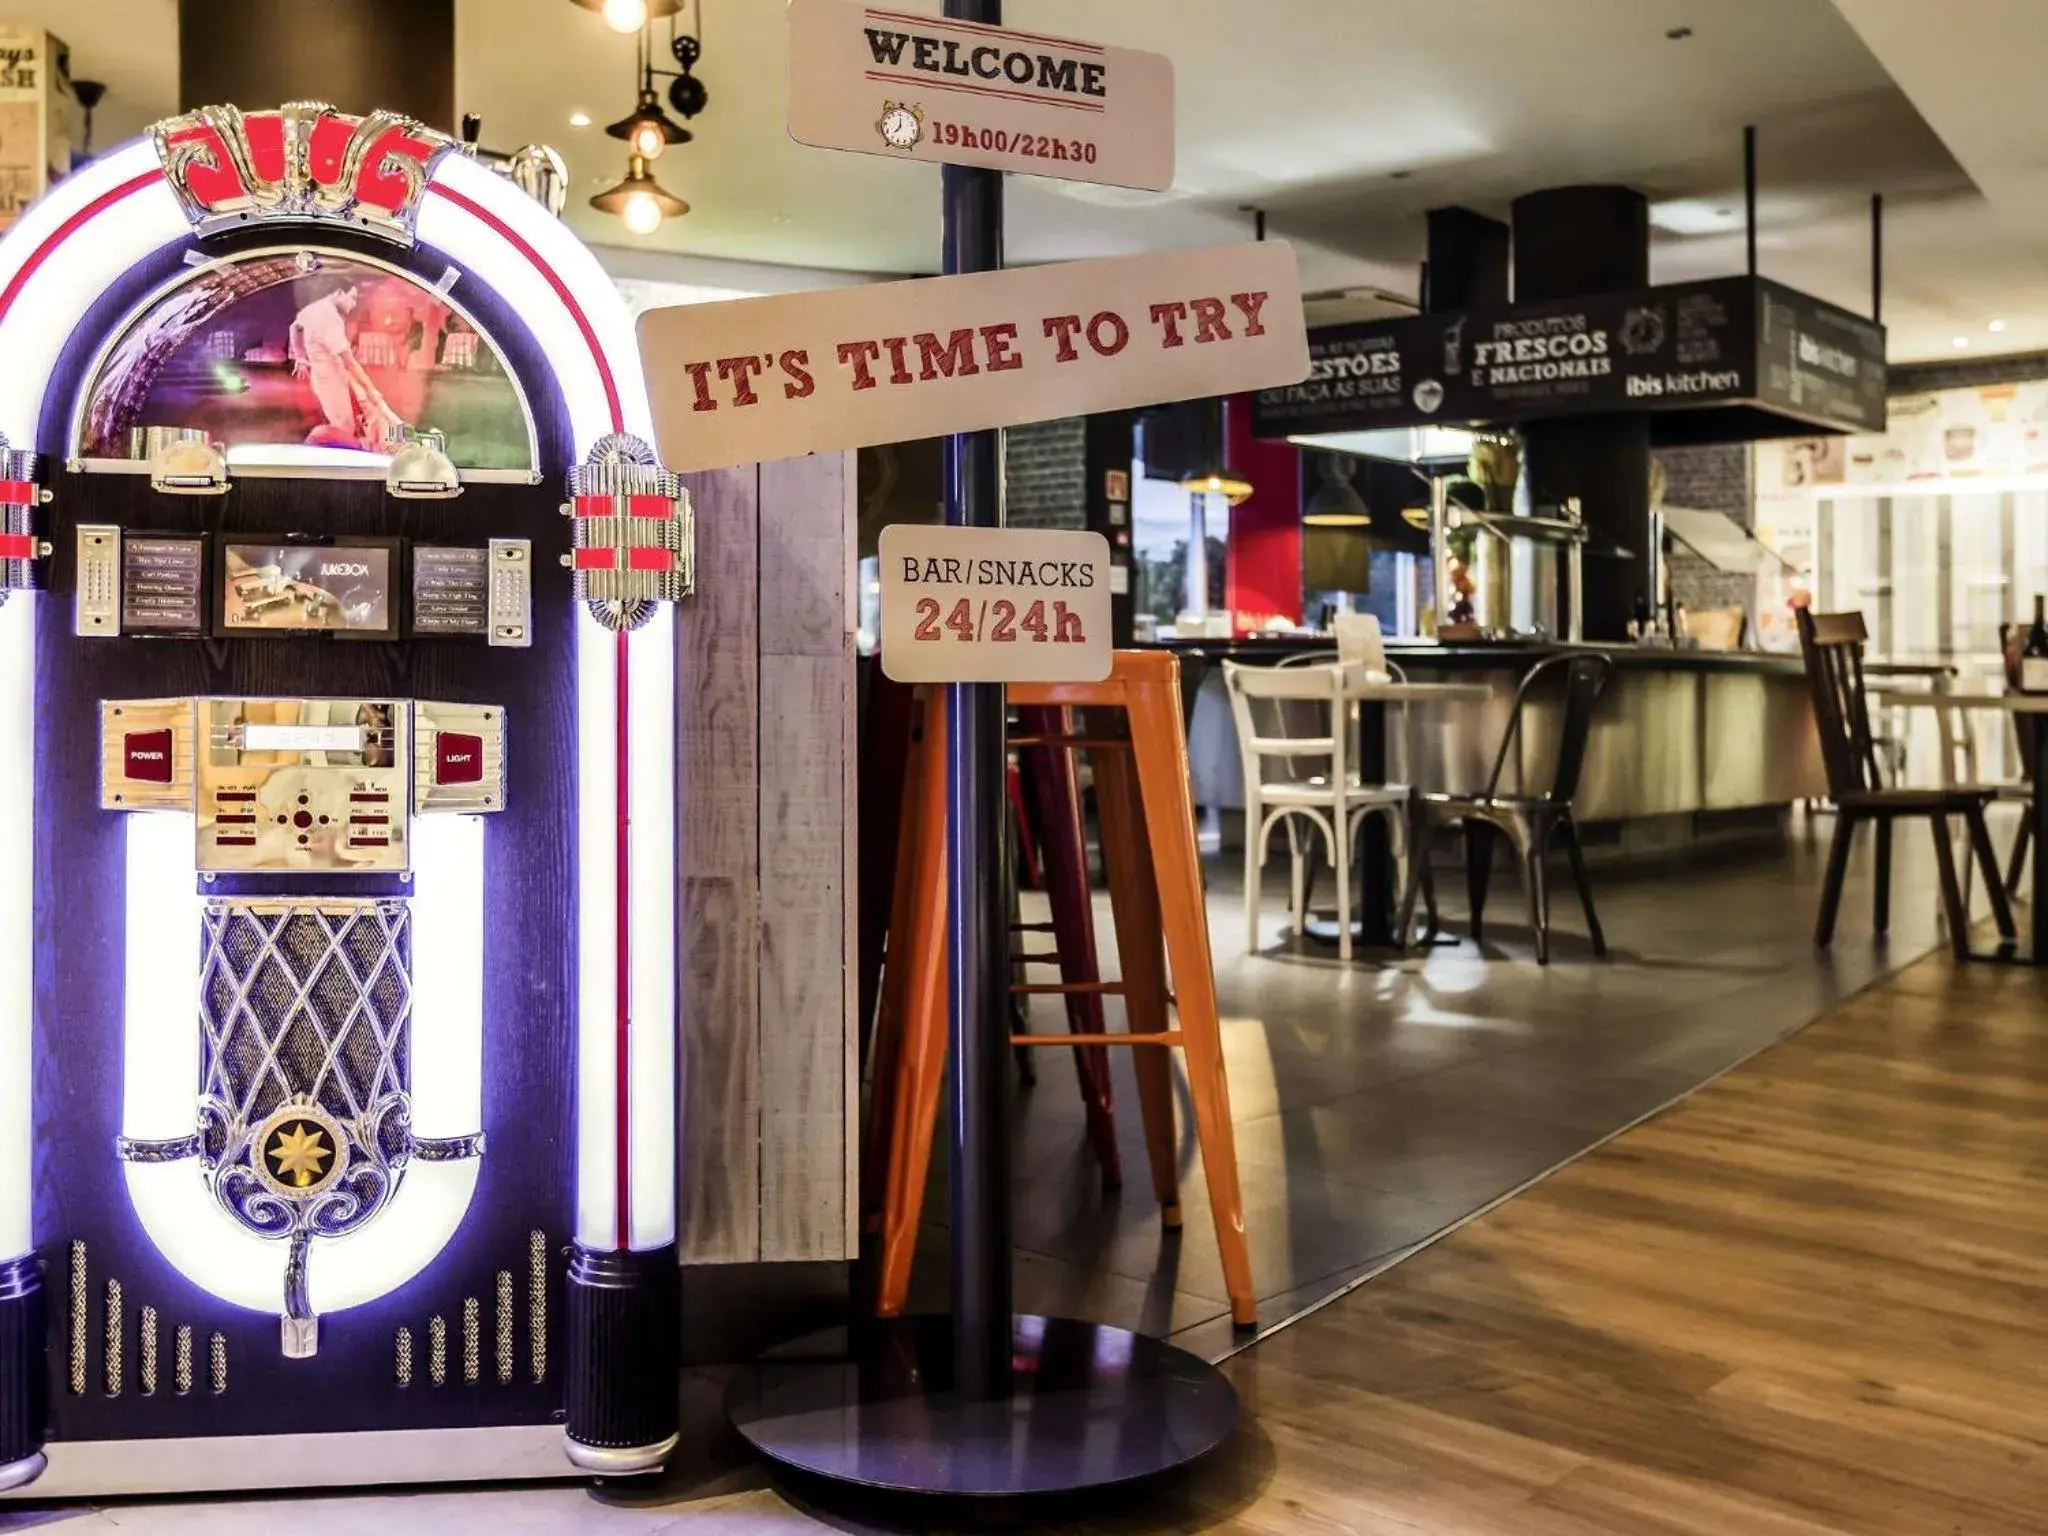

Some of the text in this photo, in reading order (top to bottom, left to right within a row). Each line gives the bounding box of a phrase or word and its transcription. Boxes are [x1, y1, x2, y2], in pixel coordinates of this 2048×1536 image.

[864, 28, 1106, 97] WELCOME
[932, 121, 1097, 165] 19h00/22h30
[685, 291, 1268, 412] IT'S TIME TO TRY
[1474, 330, 1608, 366] FRESCOS
[1471, 357, 1611, 387] E NACIONAIS
[1626, 369, 1740, 397] ibis kitchen
[320, 561, 370, 577] JUKEBOX
[903, 557, 1094, 588] BAR/SNACKS
[914, 597, 1086, 643] 24/24h
[130, 751, 164, 761] POWER
[446, 754, 472, 764] LIGHT
